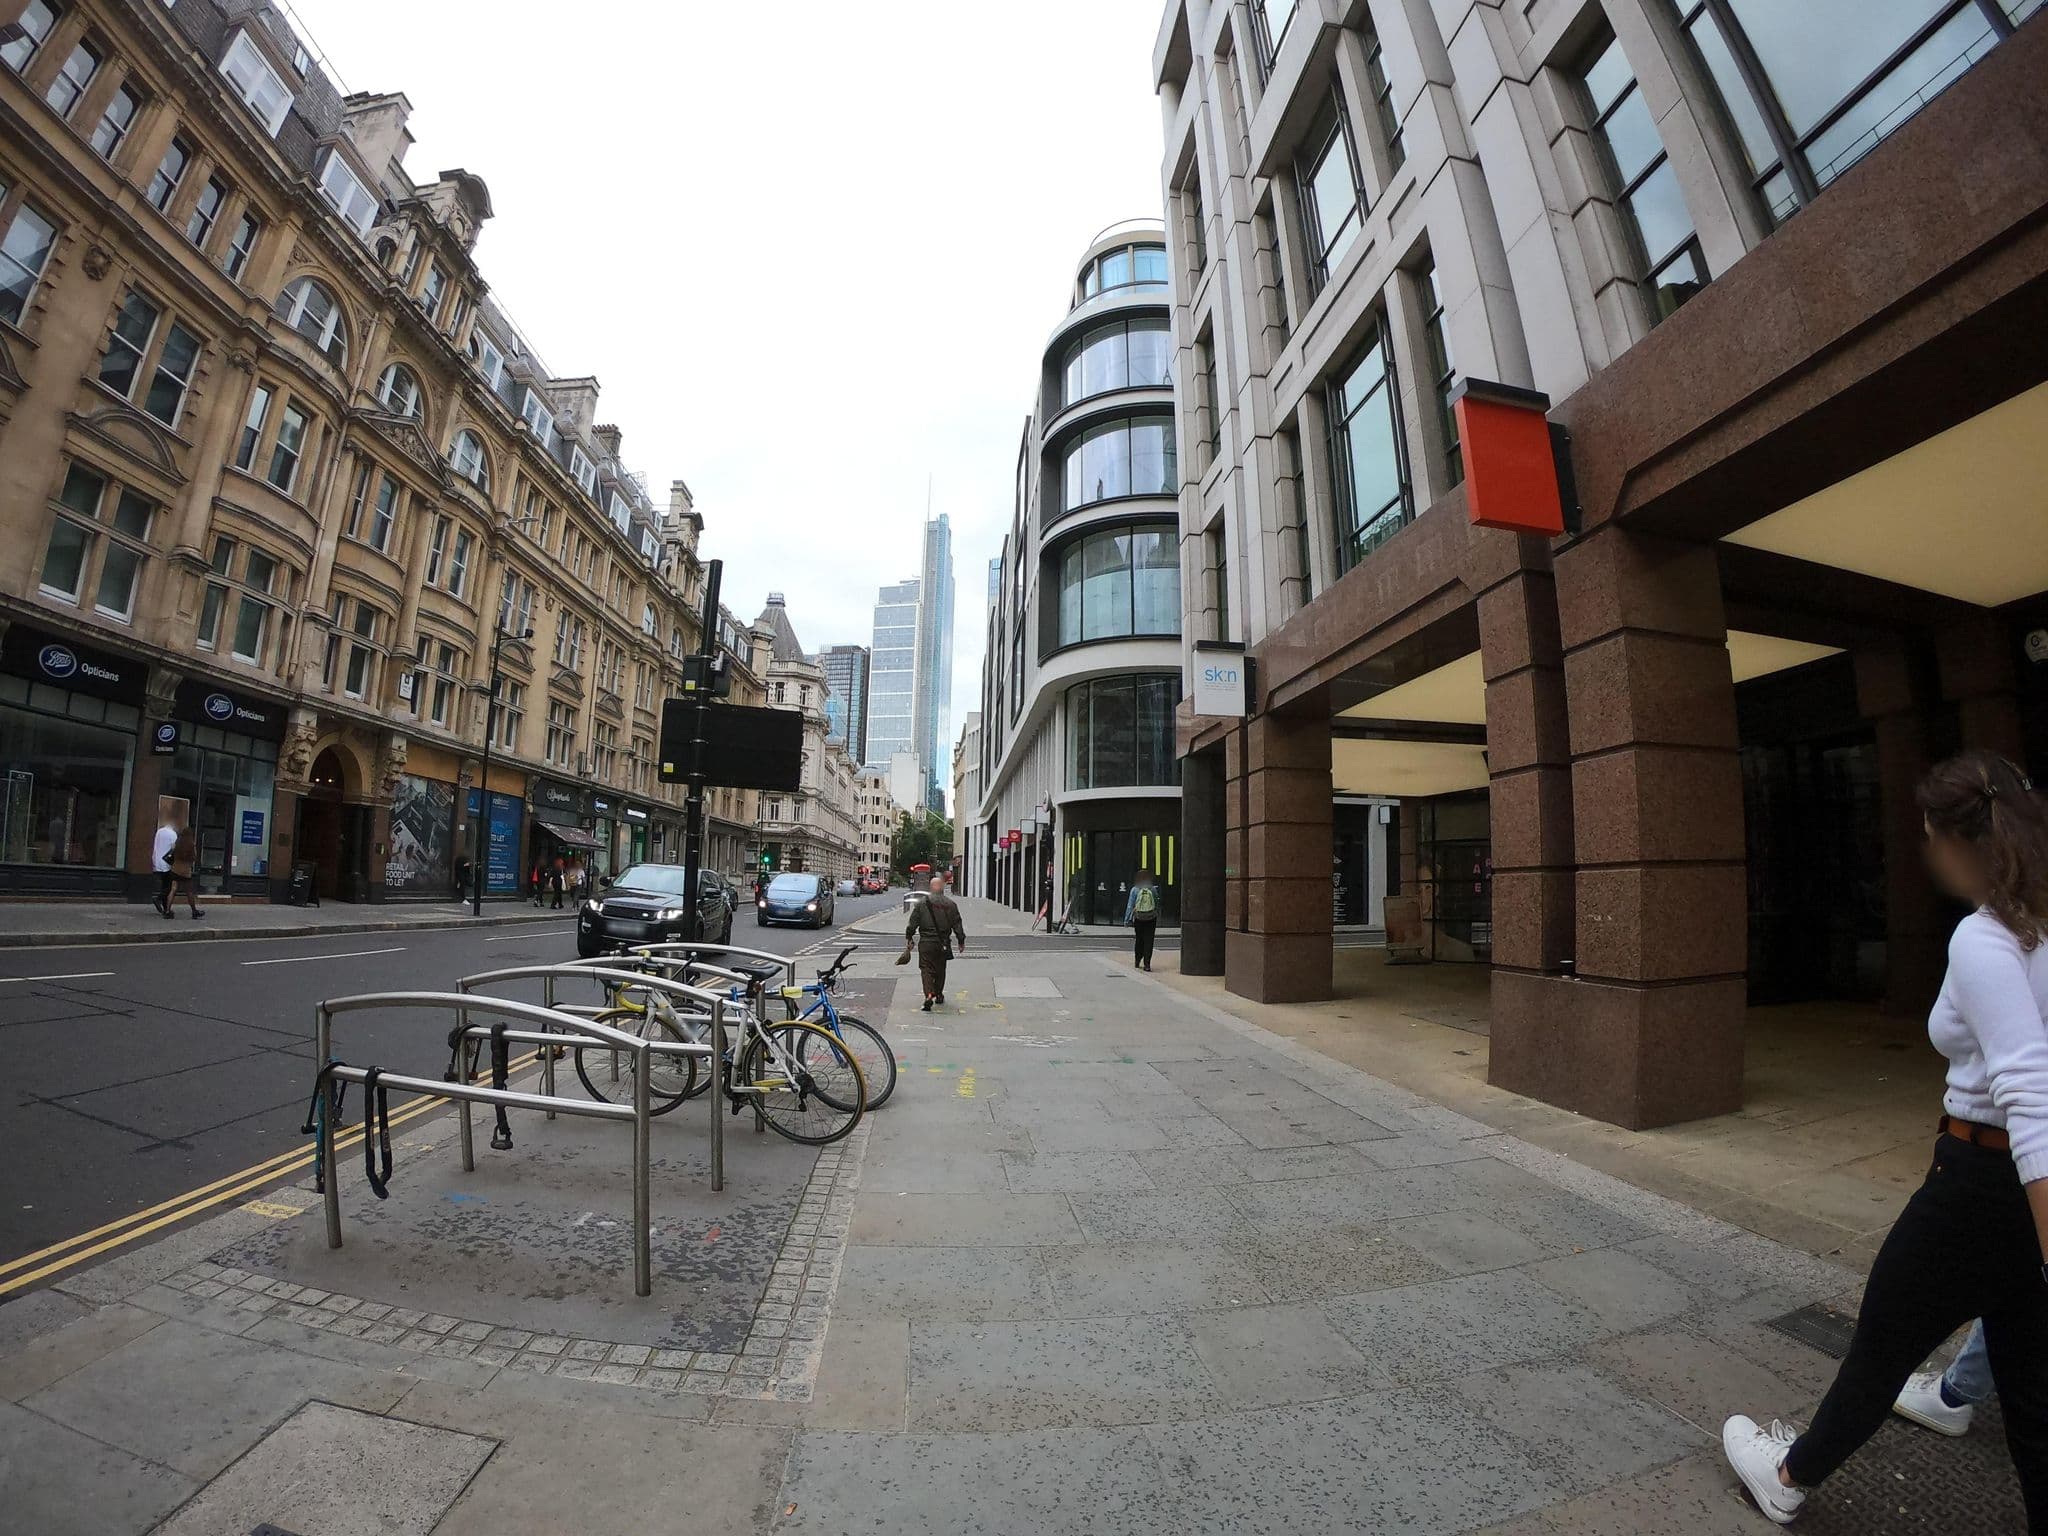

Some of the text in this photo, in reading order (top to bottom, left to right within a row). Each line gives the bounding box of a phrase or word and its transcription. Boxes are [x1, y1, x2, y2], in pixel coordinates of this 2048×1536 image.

[81, 663, 120, 682] Opticians
[1205, 665, 1237, 682] sk:n
[236, 707, 265, 722] Opticians
[385, 871, 415, 880] FOOD UNIT
[394, 879, 405, 887] LET
